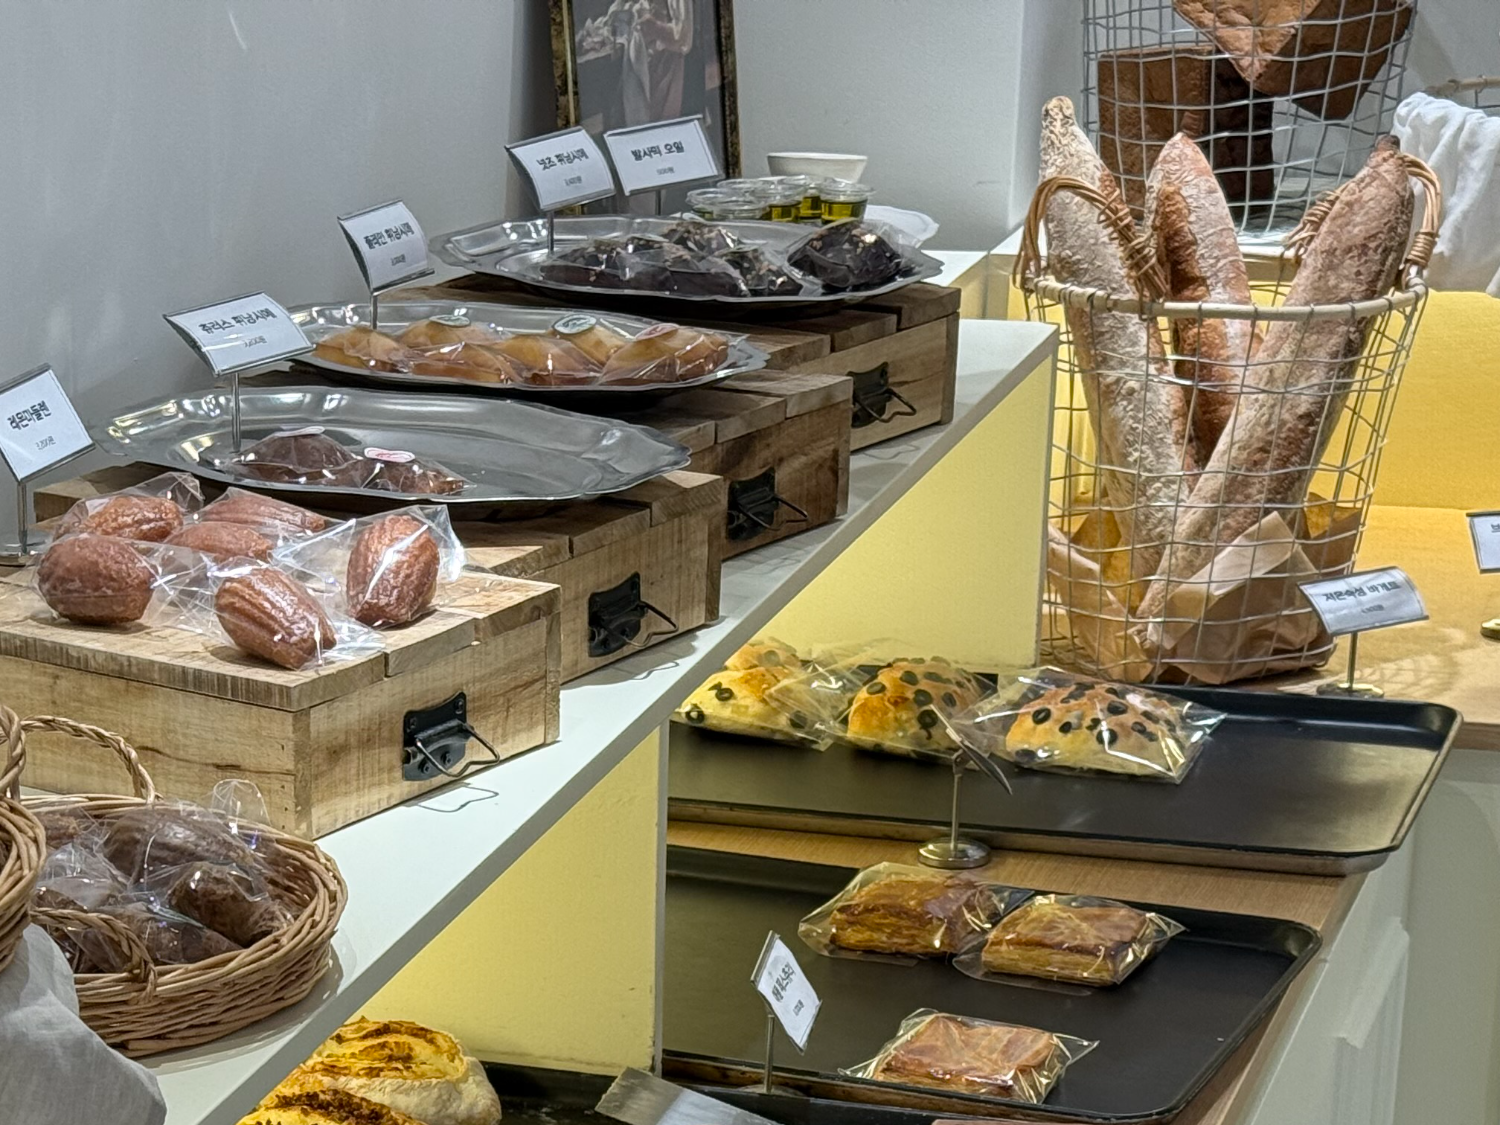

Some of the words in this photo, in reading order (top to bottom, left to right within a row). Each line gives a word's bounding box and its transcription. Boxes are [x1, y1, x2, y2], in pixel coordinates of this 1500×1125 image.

[663, 141, 686, 155] 오일
[231, 308, 278, 327] 휘낭시에
[6, 400, 52, 430] 레몬마들렌
[1367, 581, 1402, 595] 바게트
